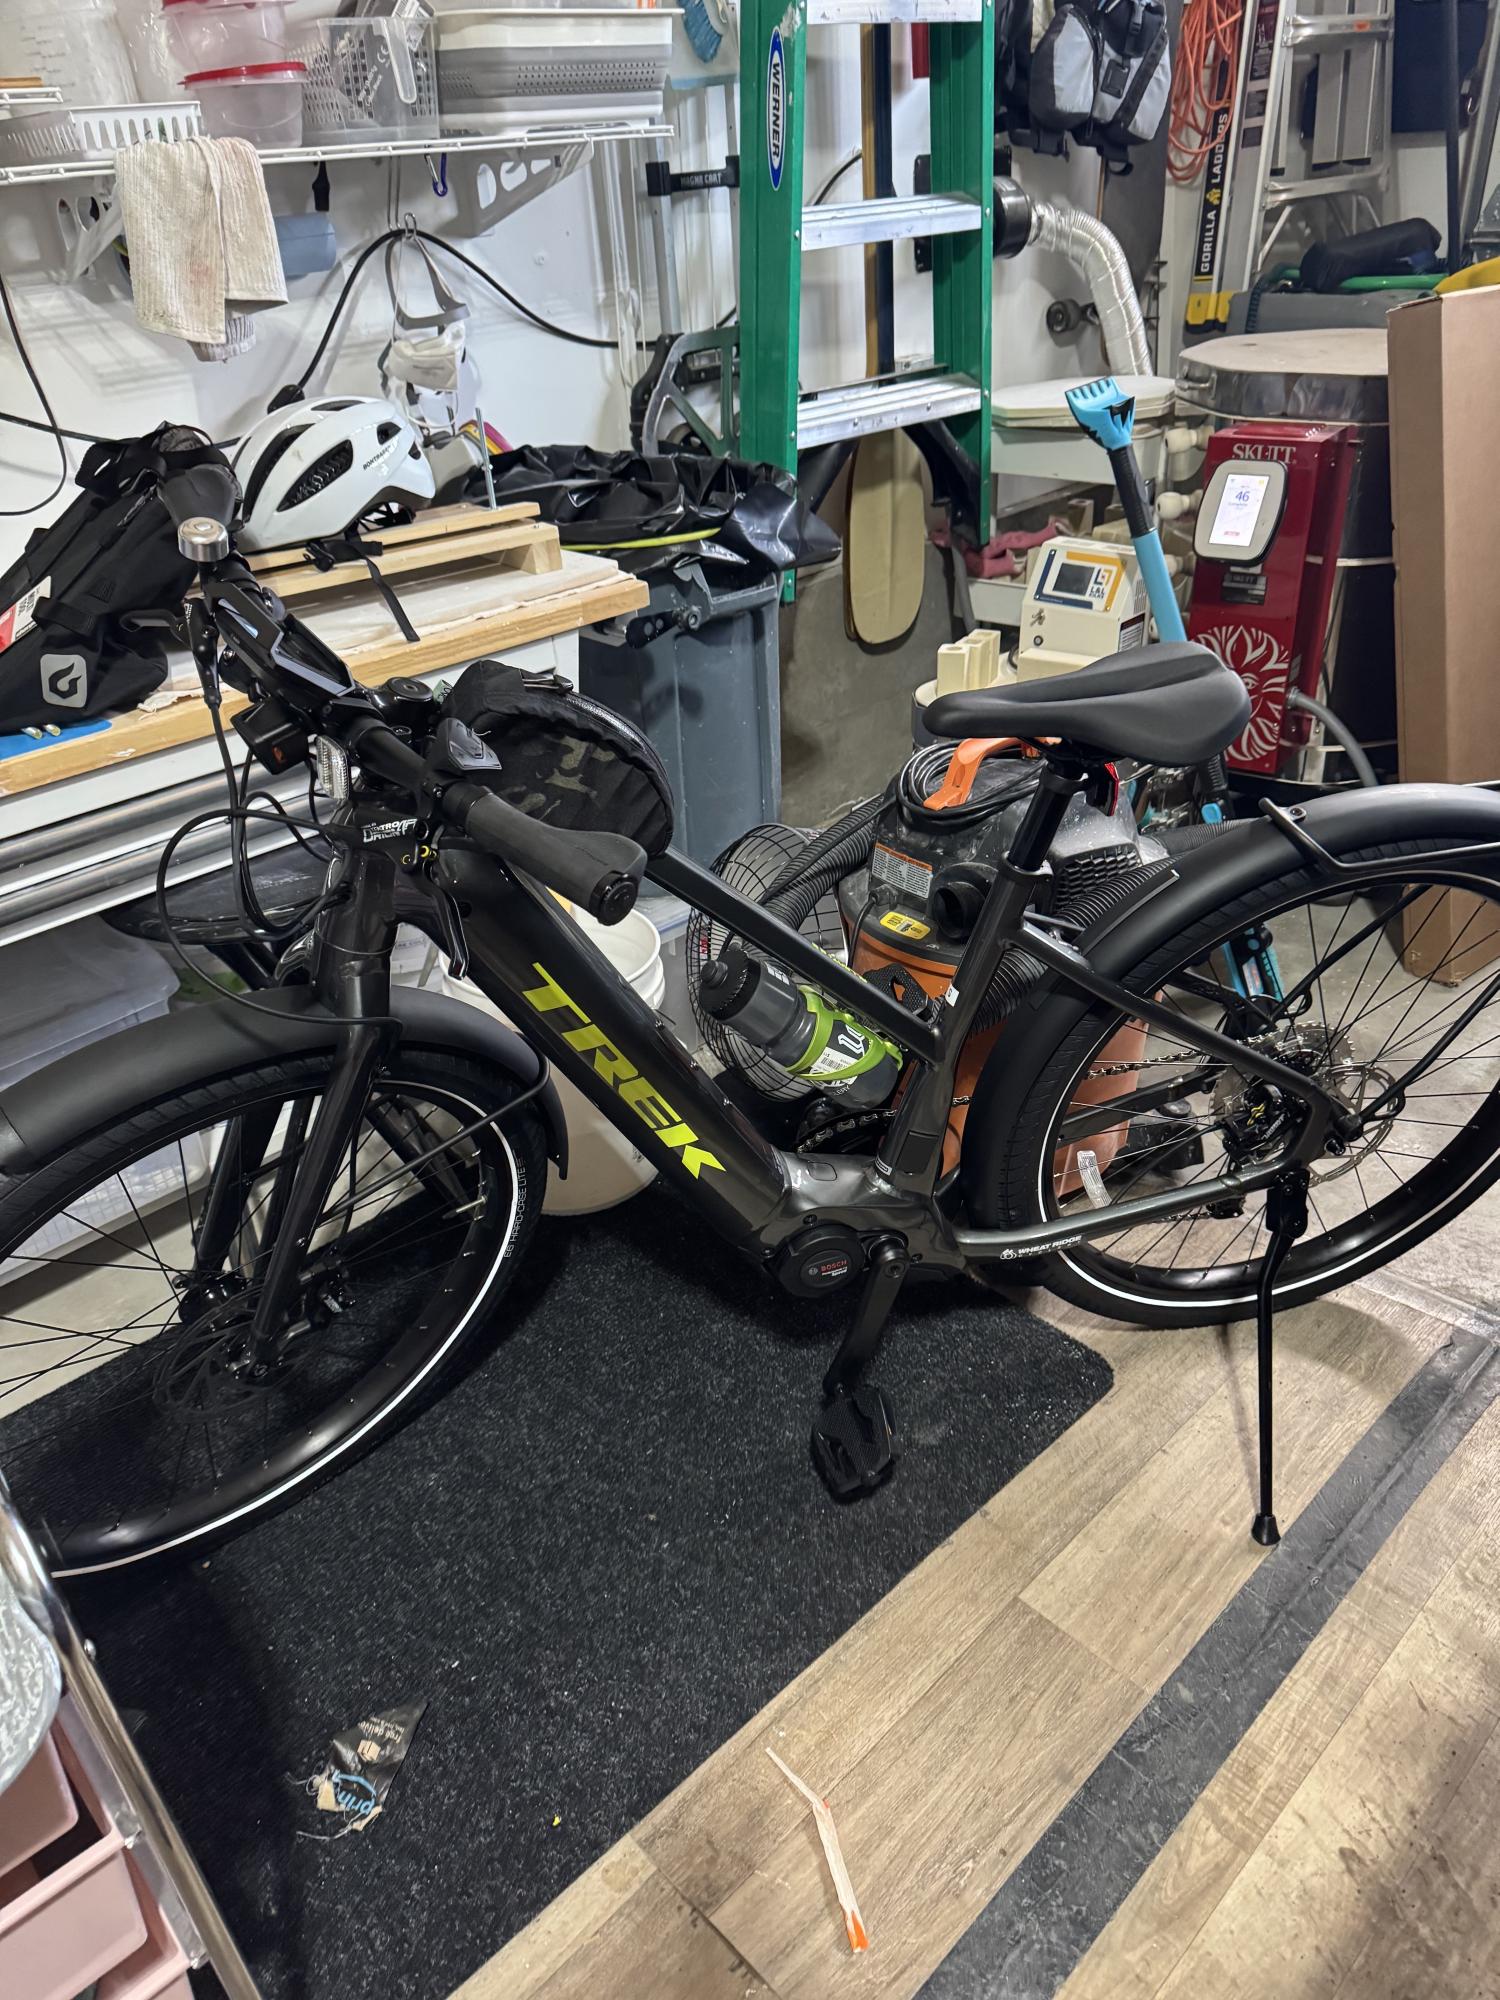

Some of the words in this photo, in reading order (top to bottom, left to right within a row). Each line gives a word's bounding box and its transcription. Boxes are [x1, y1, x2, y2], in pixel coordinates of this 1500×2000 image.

[772, 62, 780, 158] WERNER
[1200, 210, 1217, 273] GORILLA
[1232, 443, 1297, 465] SKUTT
[1235, 490, 1250, 502] 46
[521, 962, 727, 1180] TREK
[517, 1166, 527, 1184] LITE
[509, 1187, 528, 1242] HARD-CASE
[1018, 1243, 1052, 1255] WHEAT
[1052, 1235, 1082, 1248] RIDGE
[820, 1259, 848, 1272] BOSCH
